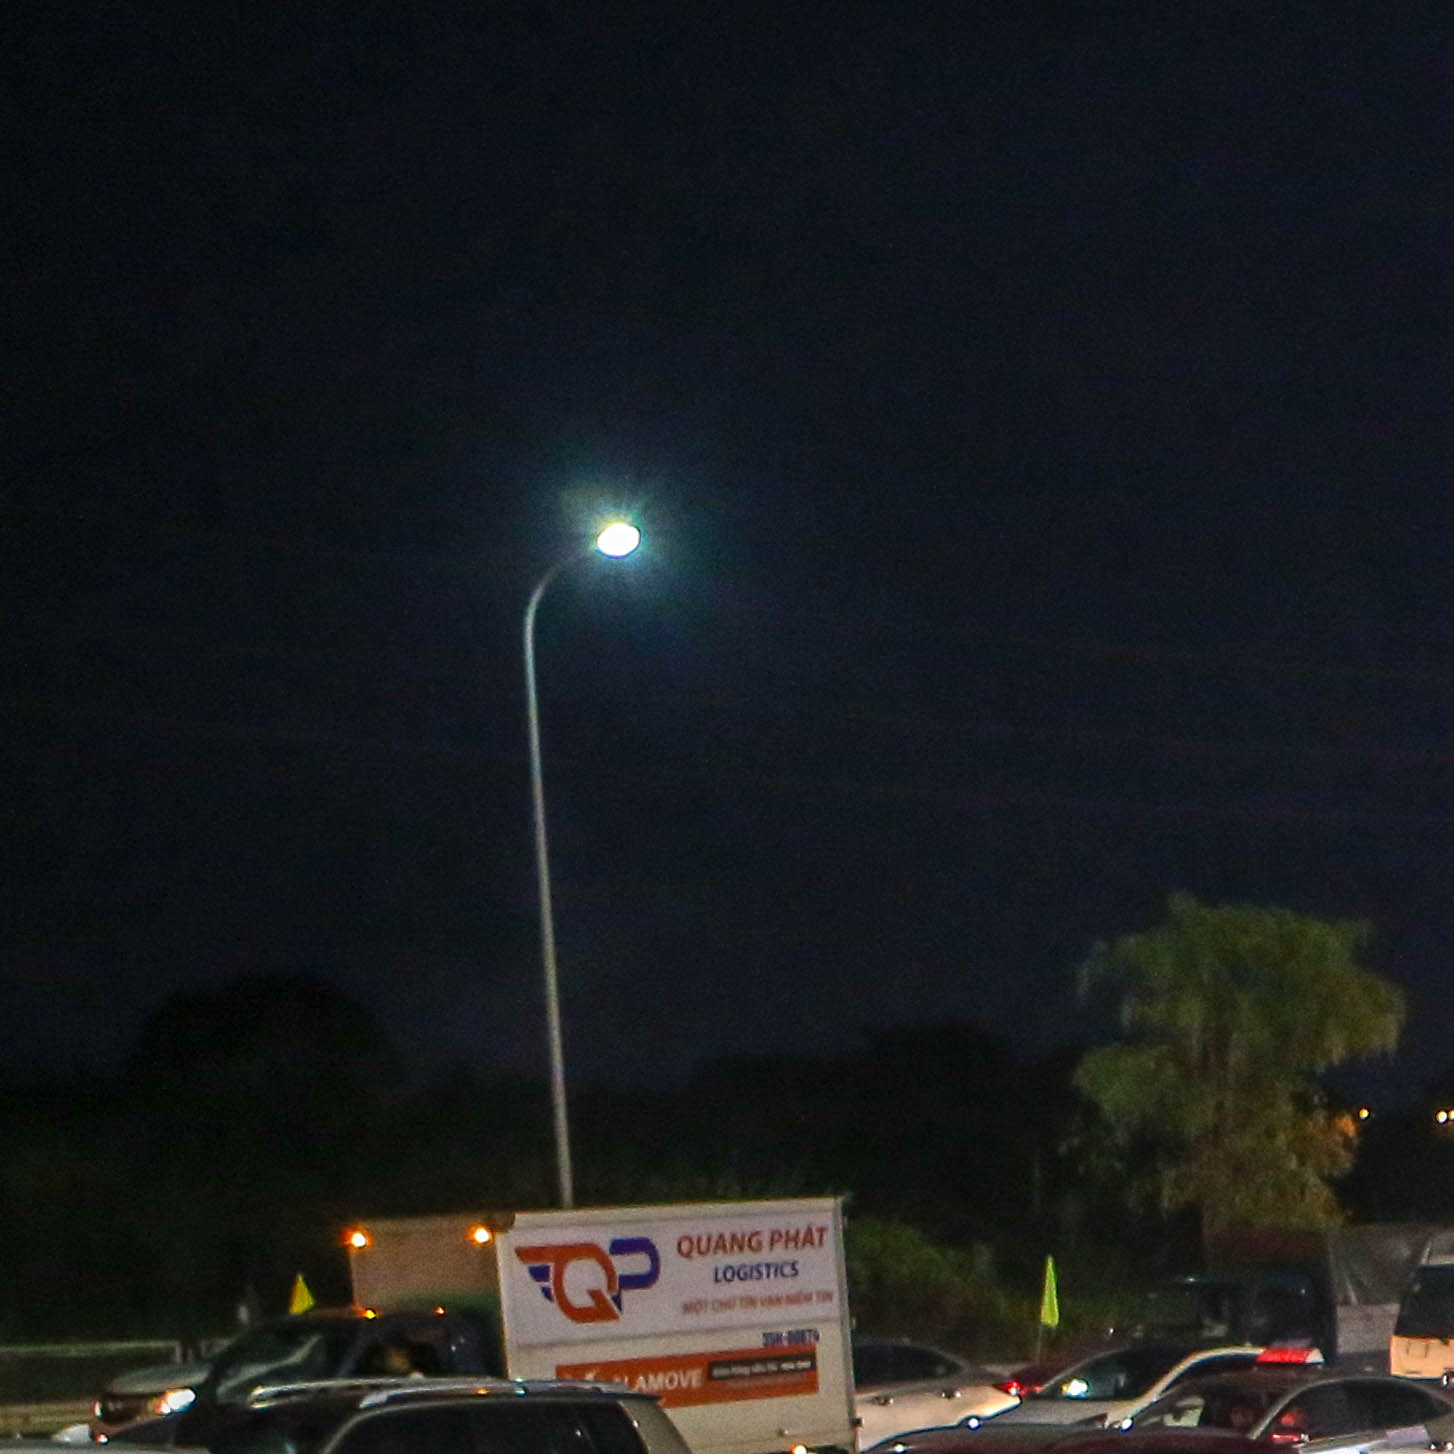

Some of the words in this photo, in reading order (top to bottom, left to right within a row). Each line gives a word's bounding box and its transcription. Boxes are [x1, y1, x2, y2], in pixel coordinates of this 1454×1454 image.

[677, 1229, 764, 1259] QUANG
[769, 1223, 828, 1251] PHÁT
[714, 1260, 799, 1283] LOGISTICS
